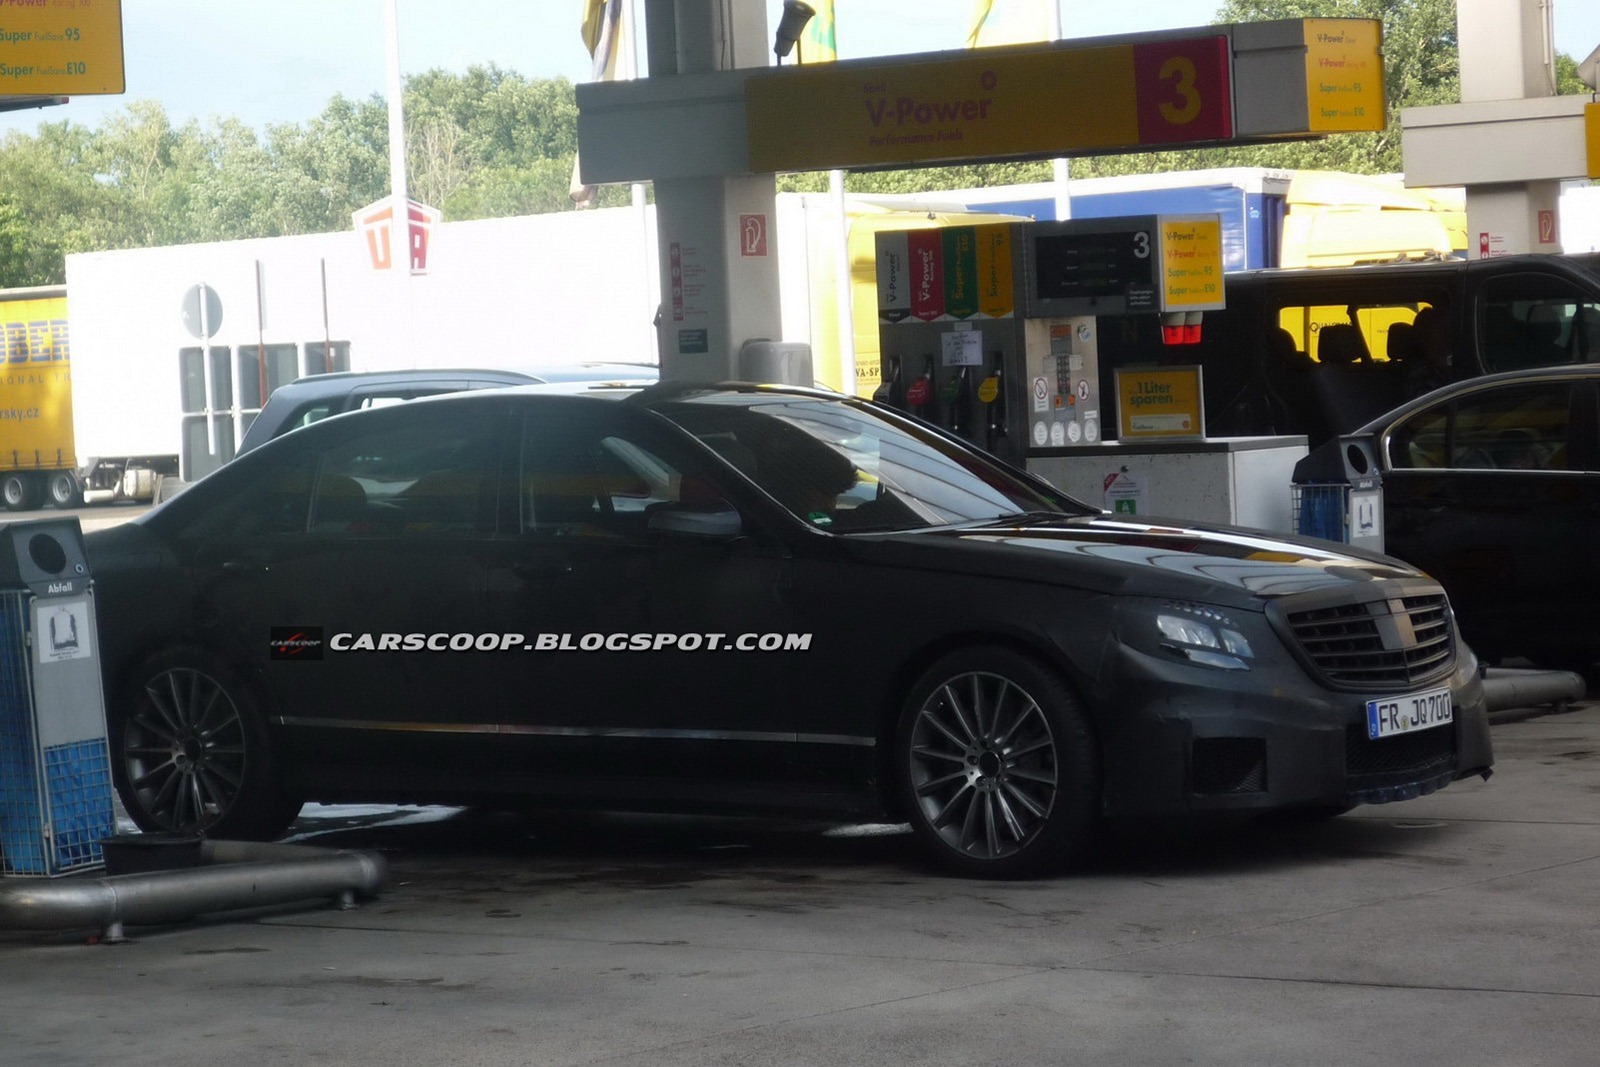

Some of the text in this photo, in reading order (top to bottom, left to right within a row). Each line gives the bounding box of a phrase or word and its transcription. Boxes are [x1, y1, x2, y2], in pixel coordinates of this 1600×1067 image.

[0, 29, 33, 44] Super
[65, 29, 80, 41] 95
[1317, 34, 1344, 43] V-Power
[0, 64, 35, 78] Super
[66, 62, 87, 75] E10
[1318, 58, 1346, 68] V-Power
[1159, 56, 1202, 125] 3
[1320, 83, 1338, 94] Super
[864, 96, 992, 128] V-Power
[1321, 107, 1339, 118] Super
[1167, 231, 1195, 241] V-Power
[1133, 232, 1150, 258] 3
[1168, 250, 1196, 259] V-Power
[889, 253, 897, 302] V-Power
[922, 252, 930, 301] V-Power
[1168, 267, 1188, 278] Super
[955, 267, 964, 299] Super
[990, 266, 999, 297] Super
[1169, 285, 1188, 296] Super
[1205, 283, 1216, 293] E10
[0, 320, 69, 364] BER
[1137, 380, 1172, 394] 1 Liter
[1130, 394, 1173, 408] sparen
[0, 408, 39, 421] rsky.cz
[48, 583, 73, 594] Abfall
[1379, 703, 1400, 732] FR
[1429, 693, 1451, 722] 700
